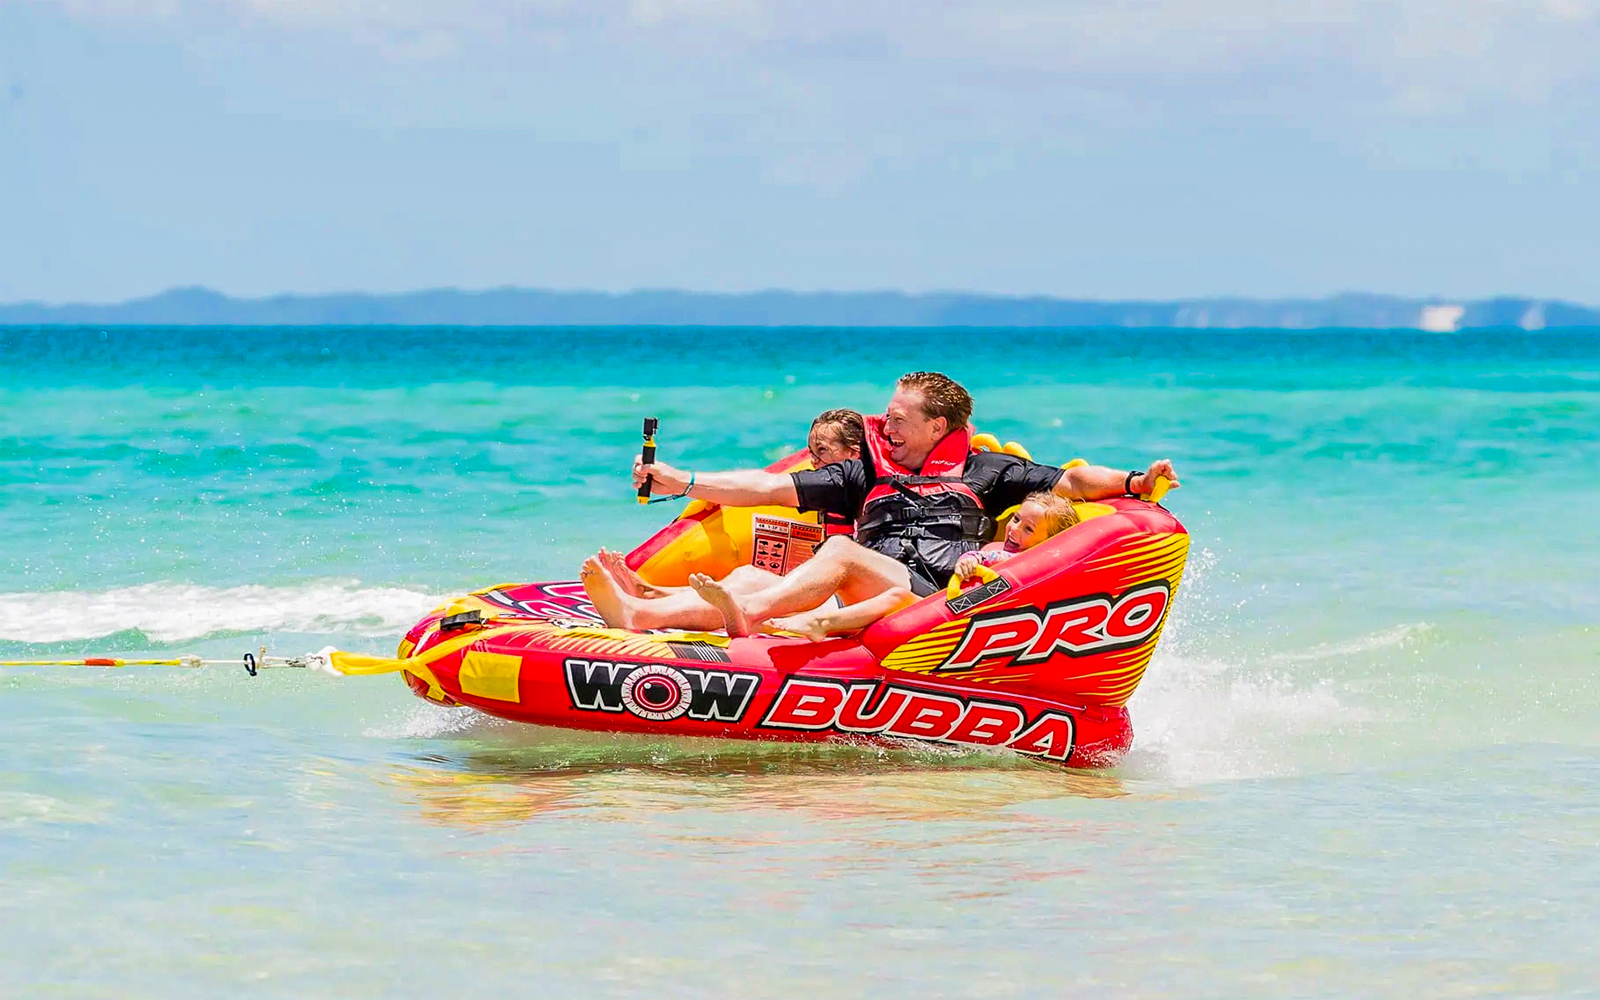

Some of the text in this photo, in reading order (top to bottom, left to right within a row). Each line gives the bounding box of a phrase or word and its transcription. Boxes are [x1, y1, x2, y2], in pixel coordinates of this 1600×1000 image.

[940, 582, 1170, 672] PRO
[565, 660, 1075, 762] WOW BUBBA
